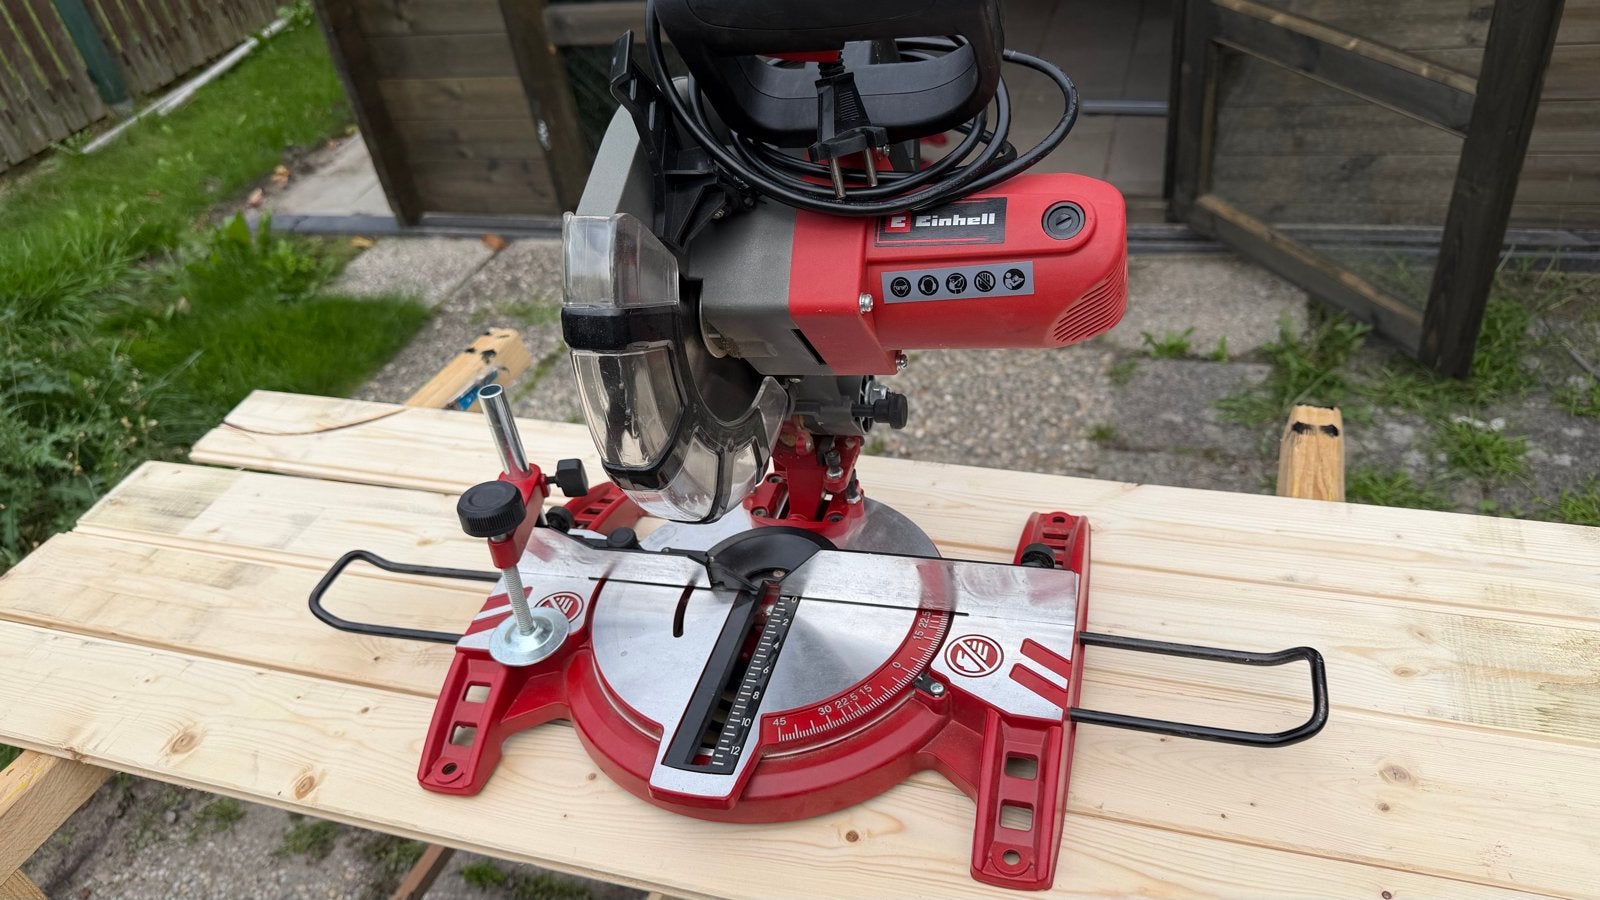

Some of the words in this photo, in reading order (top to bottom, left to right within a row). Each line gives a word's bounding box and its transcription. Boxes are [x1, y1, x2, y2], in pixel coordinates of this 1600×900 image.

[915, 213, 995, 227] Einhell
[790, 595, 798, 604] 0
[781, 618, 789, 626] 2
[918, 610, 932, 628] 22.5
[913, 630, 924, 640] 15
[772, 641, 780, 649] 4
[892, 661, 901, 669] 0
[762, 666, 770, 674] 6
[860, 685, 873, 695] 15
[752, 691, 760, 700] 8
[835, 694, 858, 708] 22.5
[818, 706, 832, 715] 30
[740, 717, 751, 727] 10
[730, 745, 741, 755] 12
